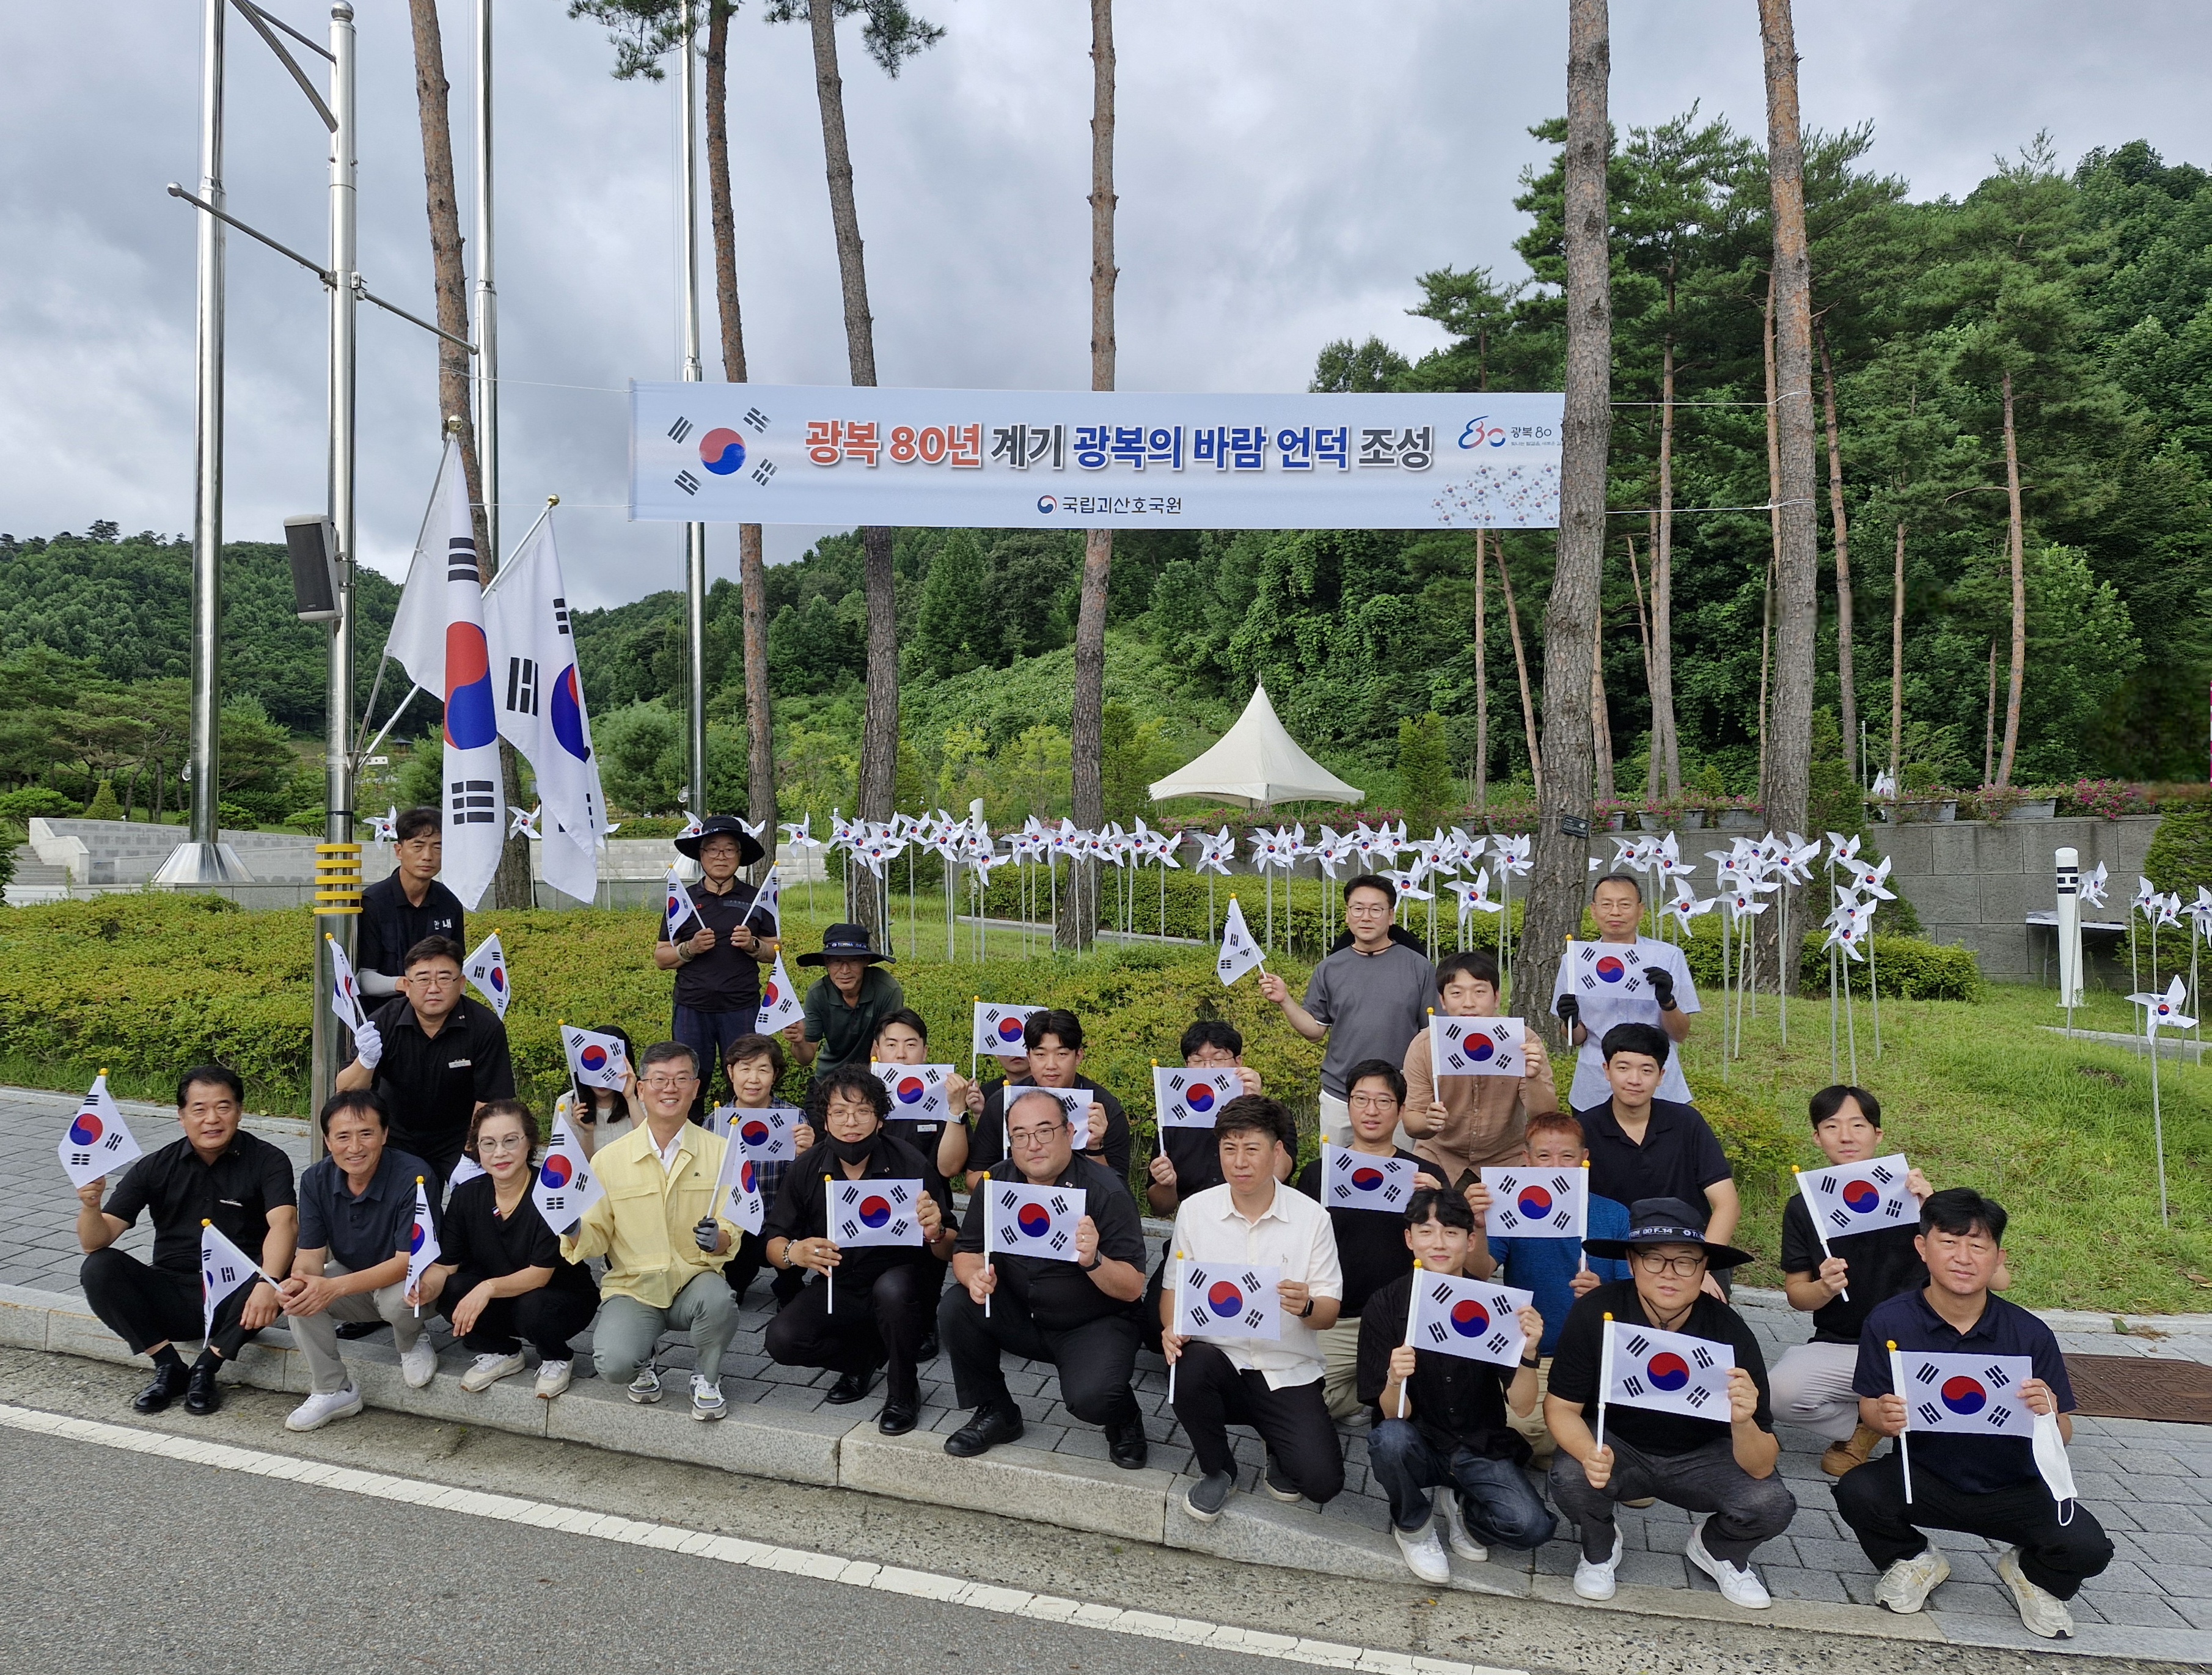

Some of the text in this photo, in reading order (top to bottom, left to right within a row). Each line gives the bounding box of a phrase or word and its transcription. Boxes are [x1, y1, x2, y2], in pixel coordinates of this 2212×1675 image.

[1511, 427, 1552, 438] 광복 80
[806, 420, 1430, 470] 광복 80년 계기 광복의 바람 언덕 조성
[1062, 496, 1182, 515] 국립괴산호국원
